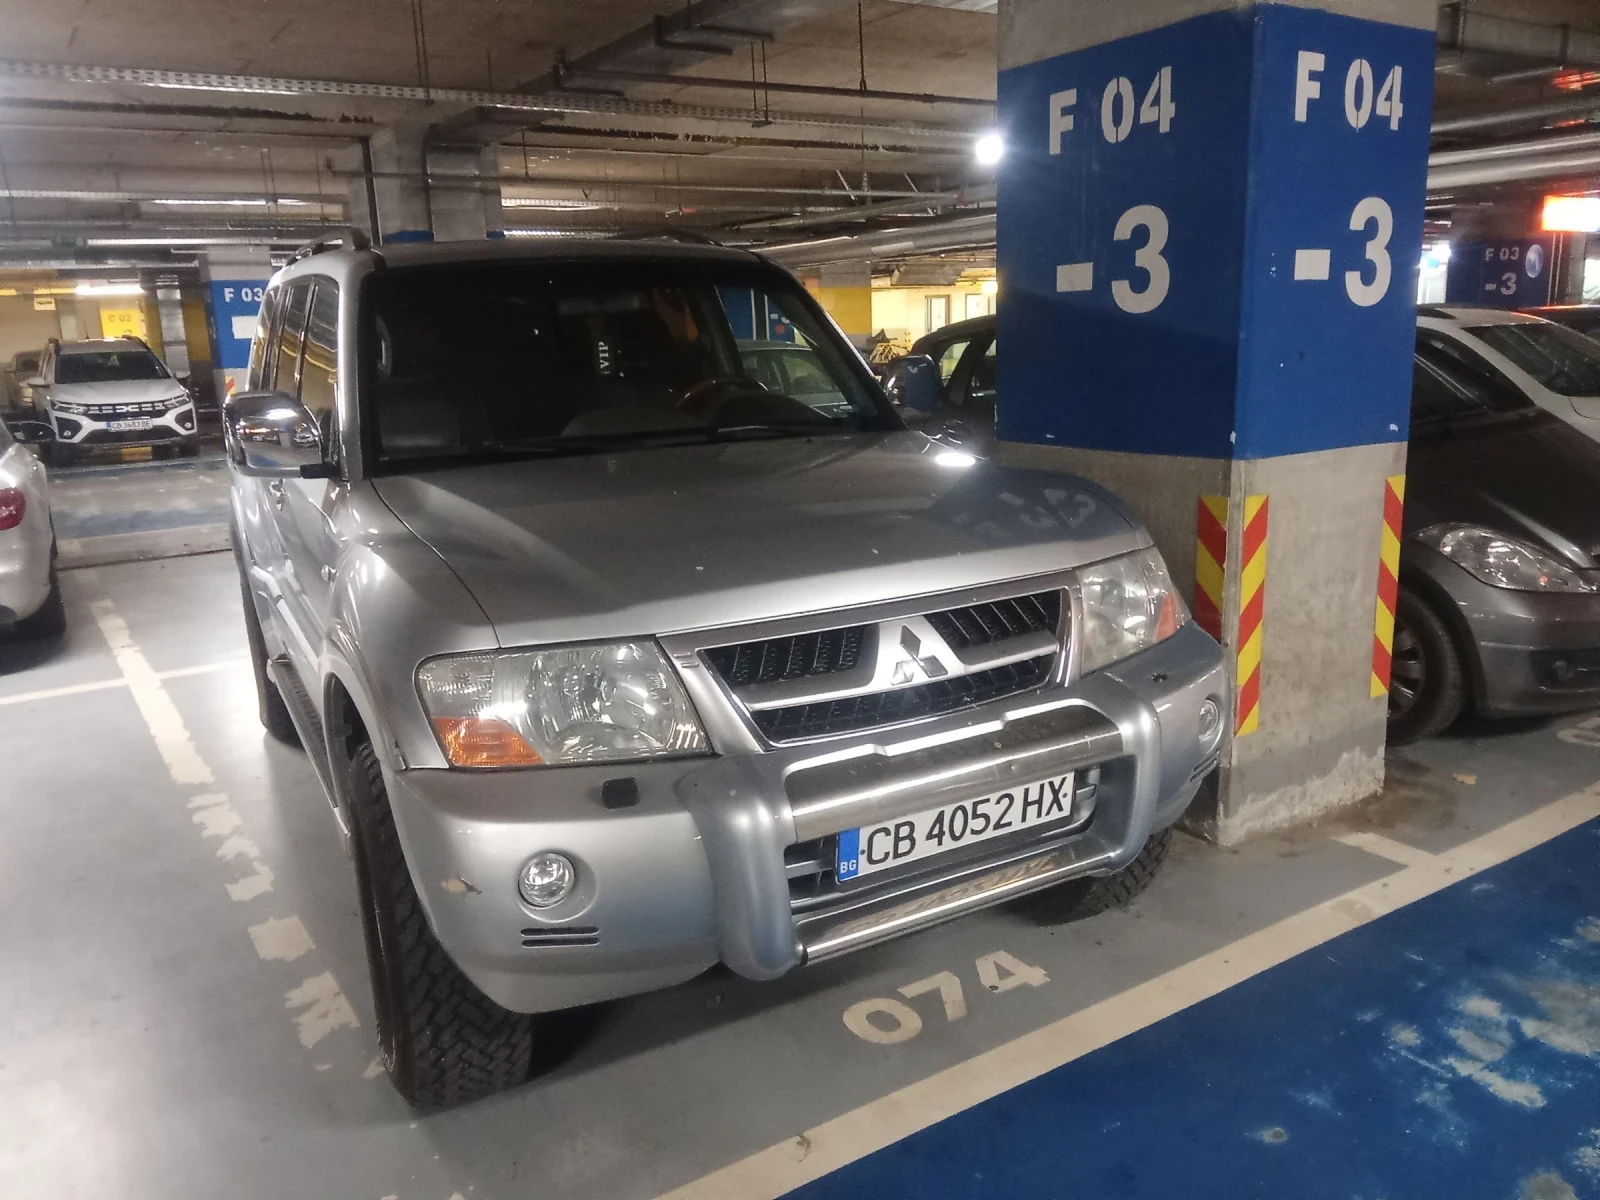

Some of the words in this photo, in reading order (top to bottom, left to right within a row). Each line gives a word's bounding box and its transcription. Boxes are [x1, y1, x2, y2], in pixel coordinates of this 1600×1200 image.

[1049, 88, 1077, 155] F
[1101, 66, 1176, 144] 04
[1294, 50, 1325, 122] F
[1344, 58, 1403, 131] 04
[1484, 247, 1495, 261] F
[1499, 246, 1520, 261] 03
[224, 287, 235, 302] F
[866, 820, 916, 866] CB
[926, 793, 1014, 847] 4052
[1021, 776, 1068, 823] HX
[840, 858, 857, 874] BG
[842, 950, 1050, 1045] 074
